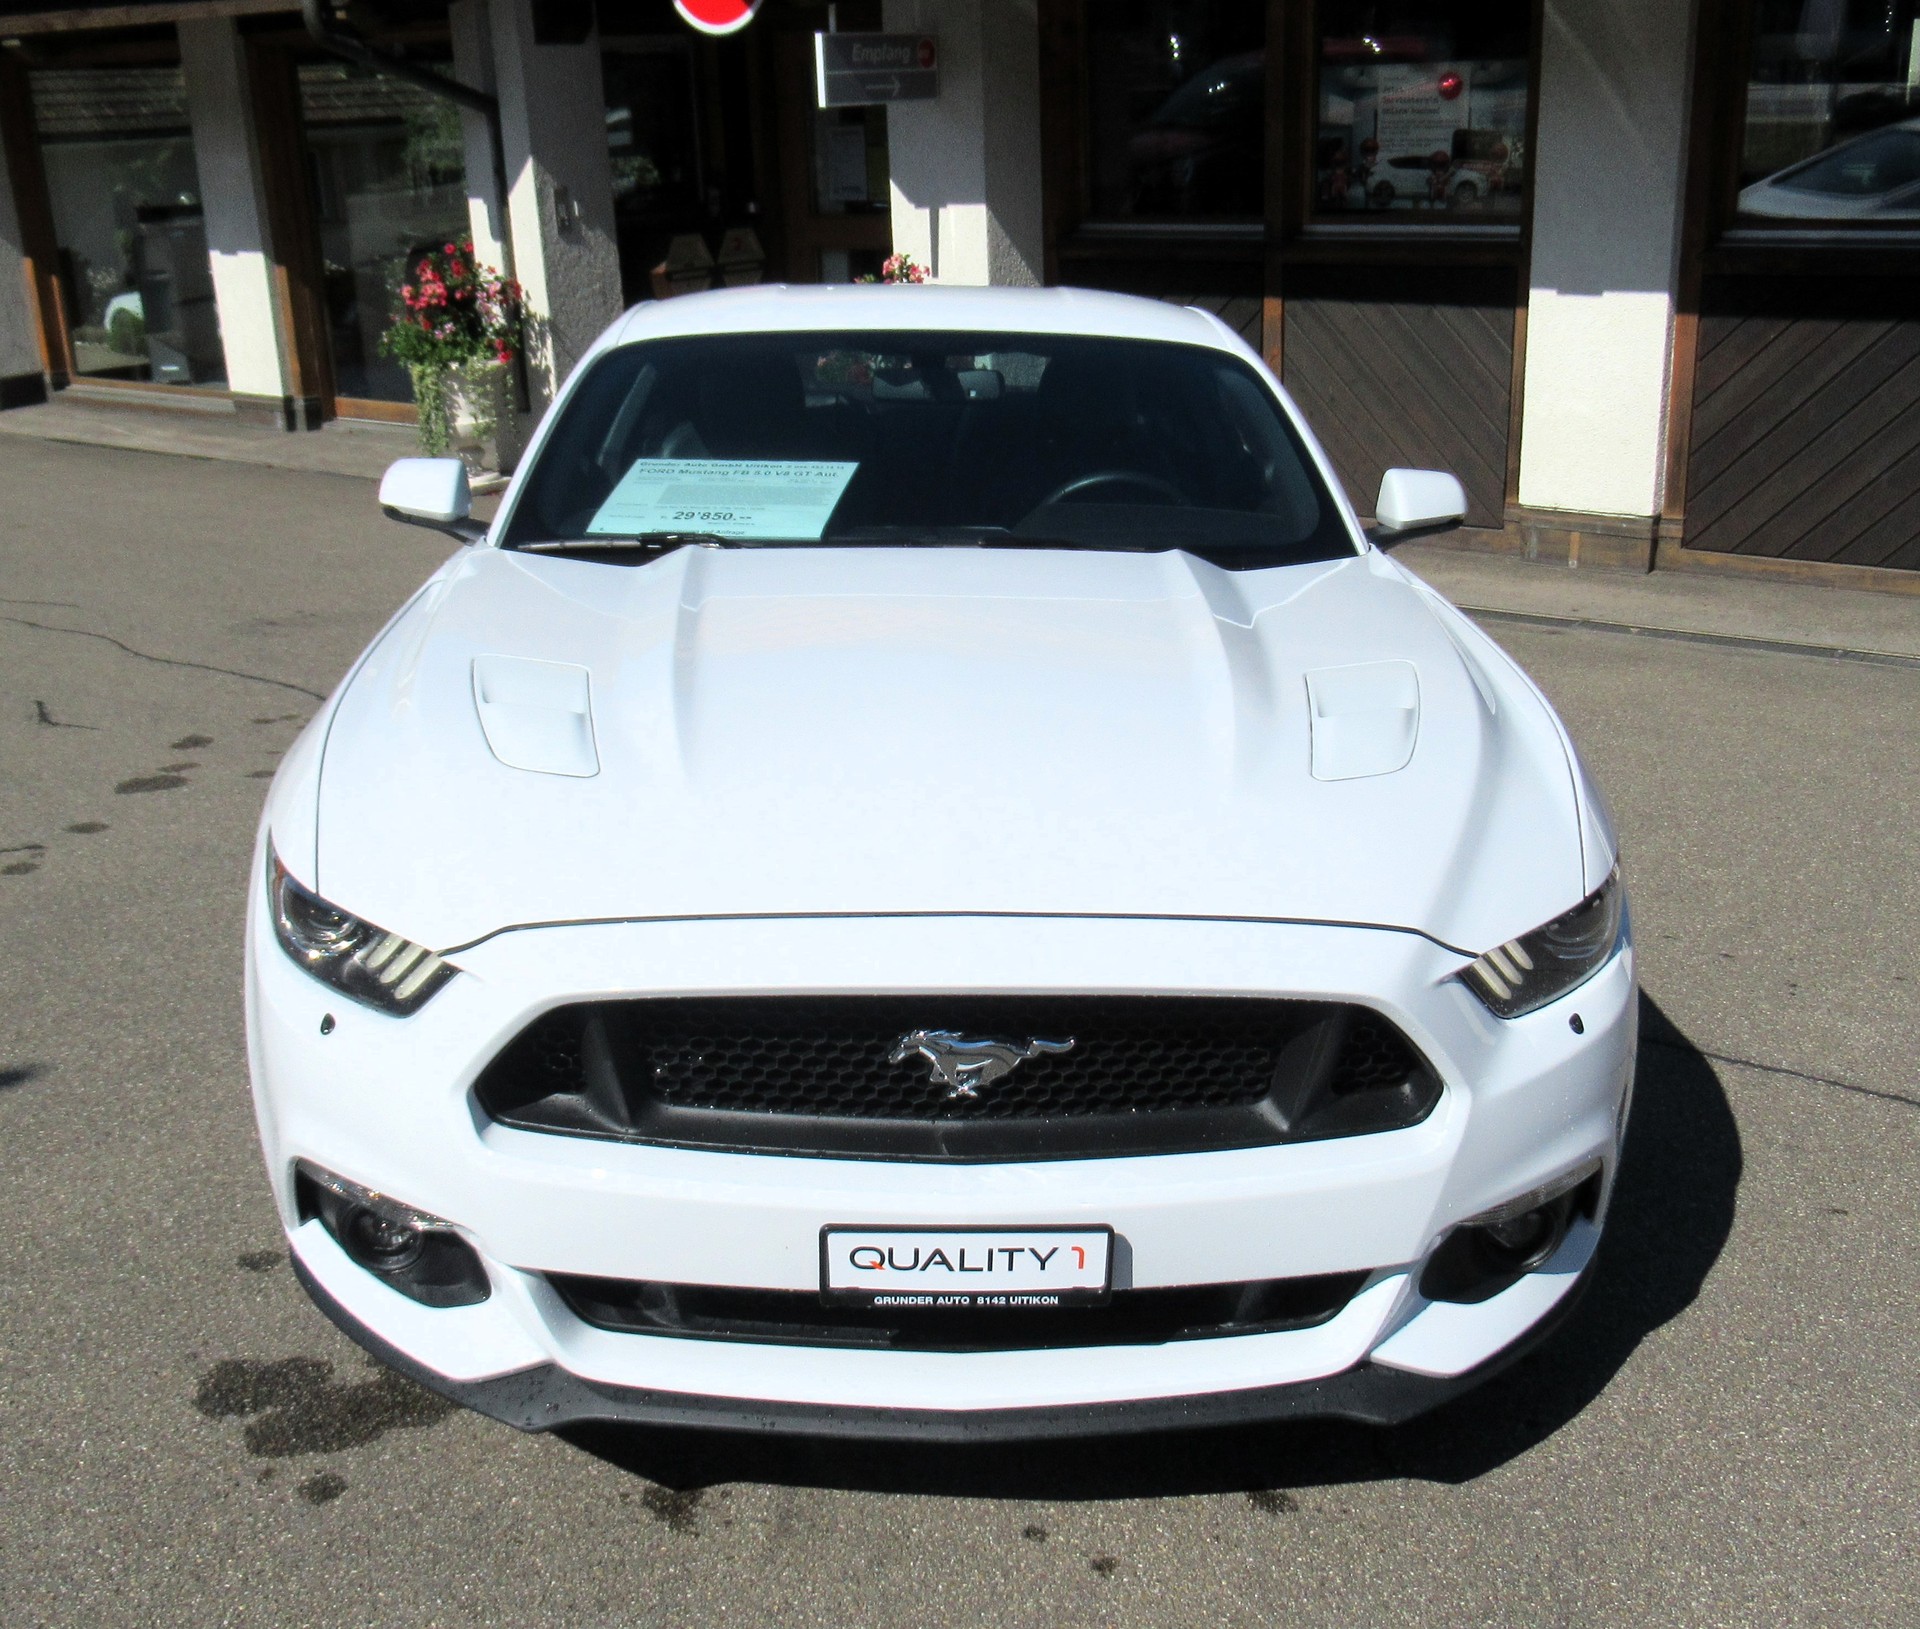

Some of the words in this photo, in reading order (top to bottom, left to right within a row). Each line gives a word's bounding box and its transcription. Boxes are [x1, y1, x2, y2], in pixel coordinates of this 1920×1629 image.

[678, 469, 730, 477] Mustang
[850, 1245, 1060, 1272] QUALITY
[873, 1295, 934, 1306] GRUNDER
[936, 1295, 970, 1306] AUTO
[976, 1295, 1006, 1306] 8142
[1008, 1295, 1059, 1306] UITIKON
